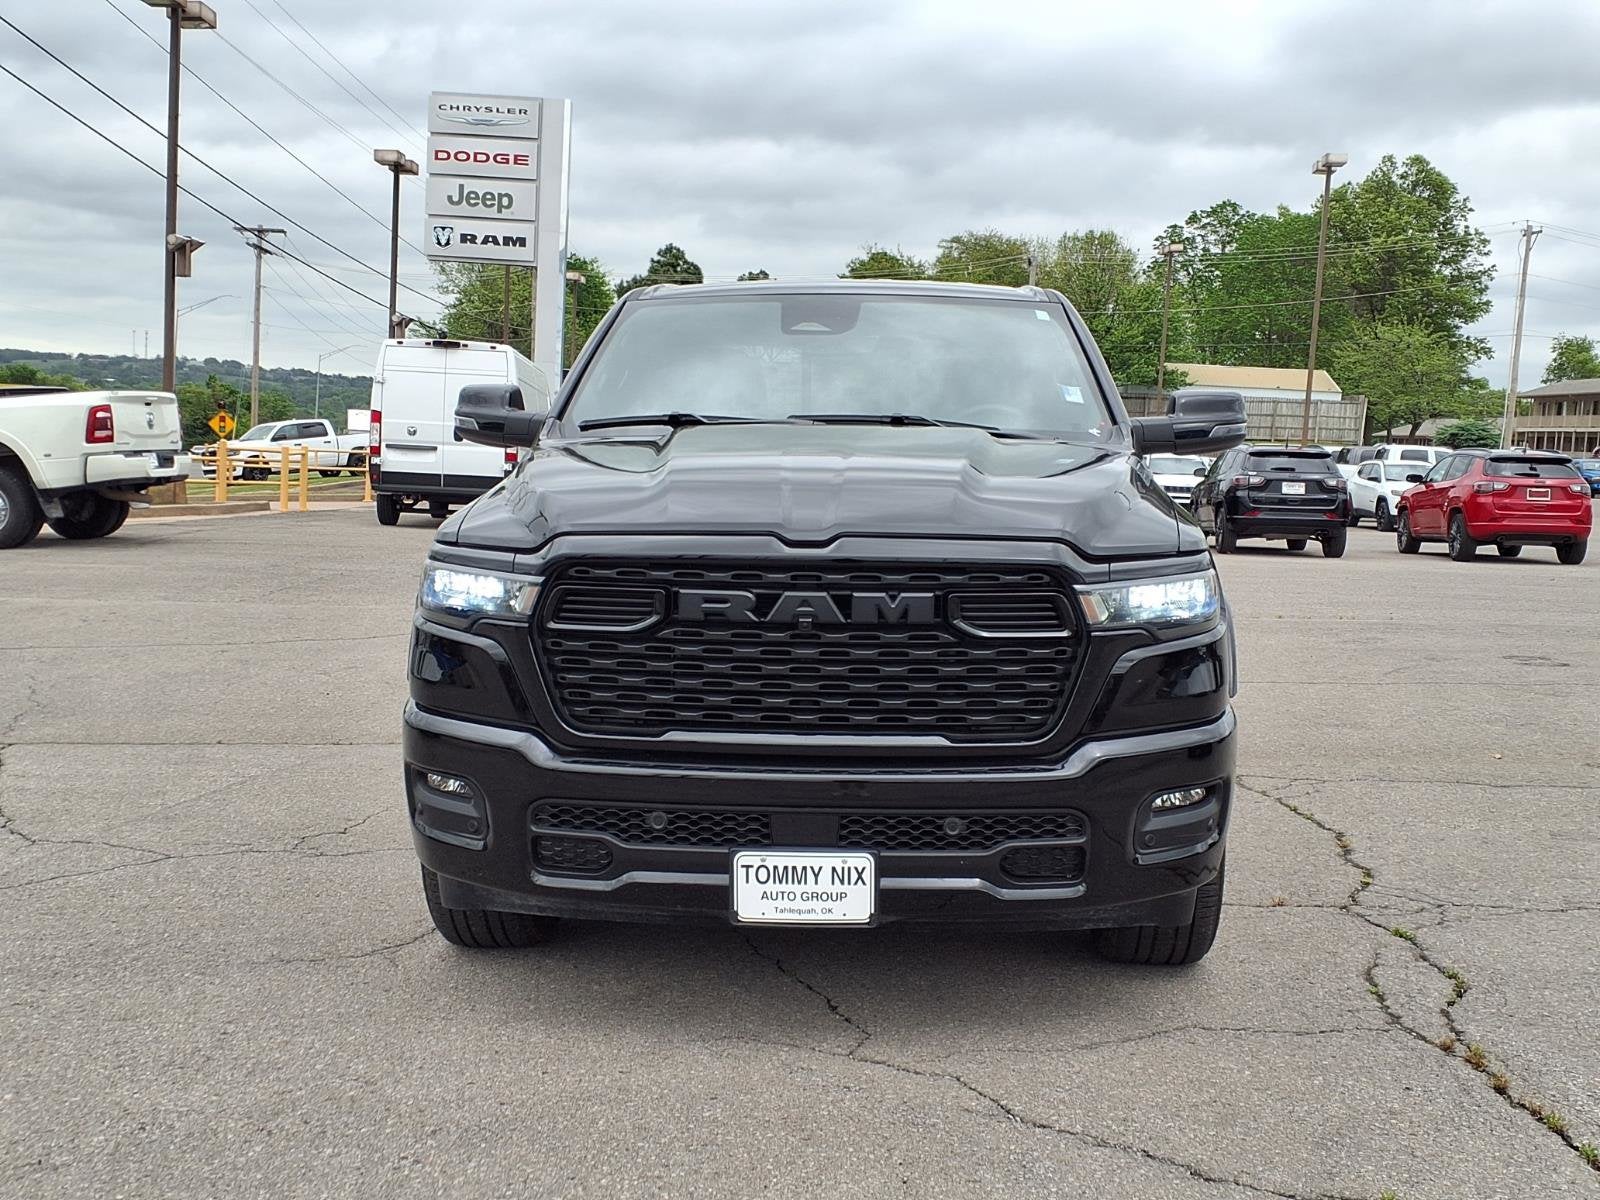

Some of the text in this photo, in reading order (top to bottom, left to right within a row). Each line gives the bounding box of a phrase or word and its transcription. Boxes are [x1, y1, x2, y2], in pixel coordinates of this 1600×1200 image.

[438, 104, 529, 115] CHRYSLER
[434, 149, 530, 166] DODGE
[447, 183, 514, 214] Jeep
[459, 233, 527, 248] RAM
[678, 589, 935, 624] RAM
[740, 864, 867, 886] TOMMY NIX
[760, 890, 848, 903] AUTO GROUP
[774, 906, 834, 916] Tahlequah, OK
